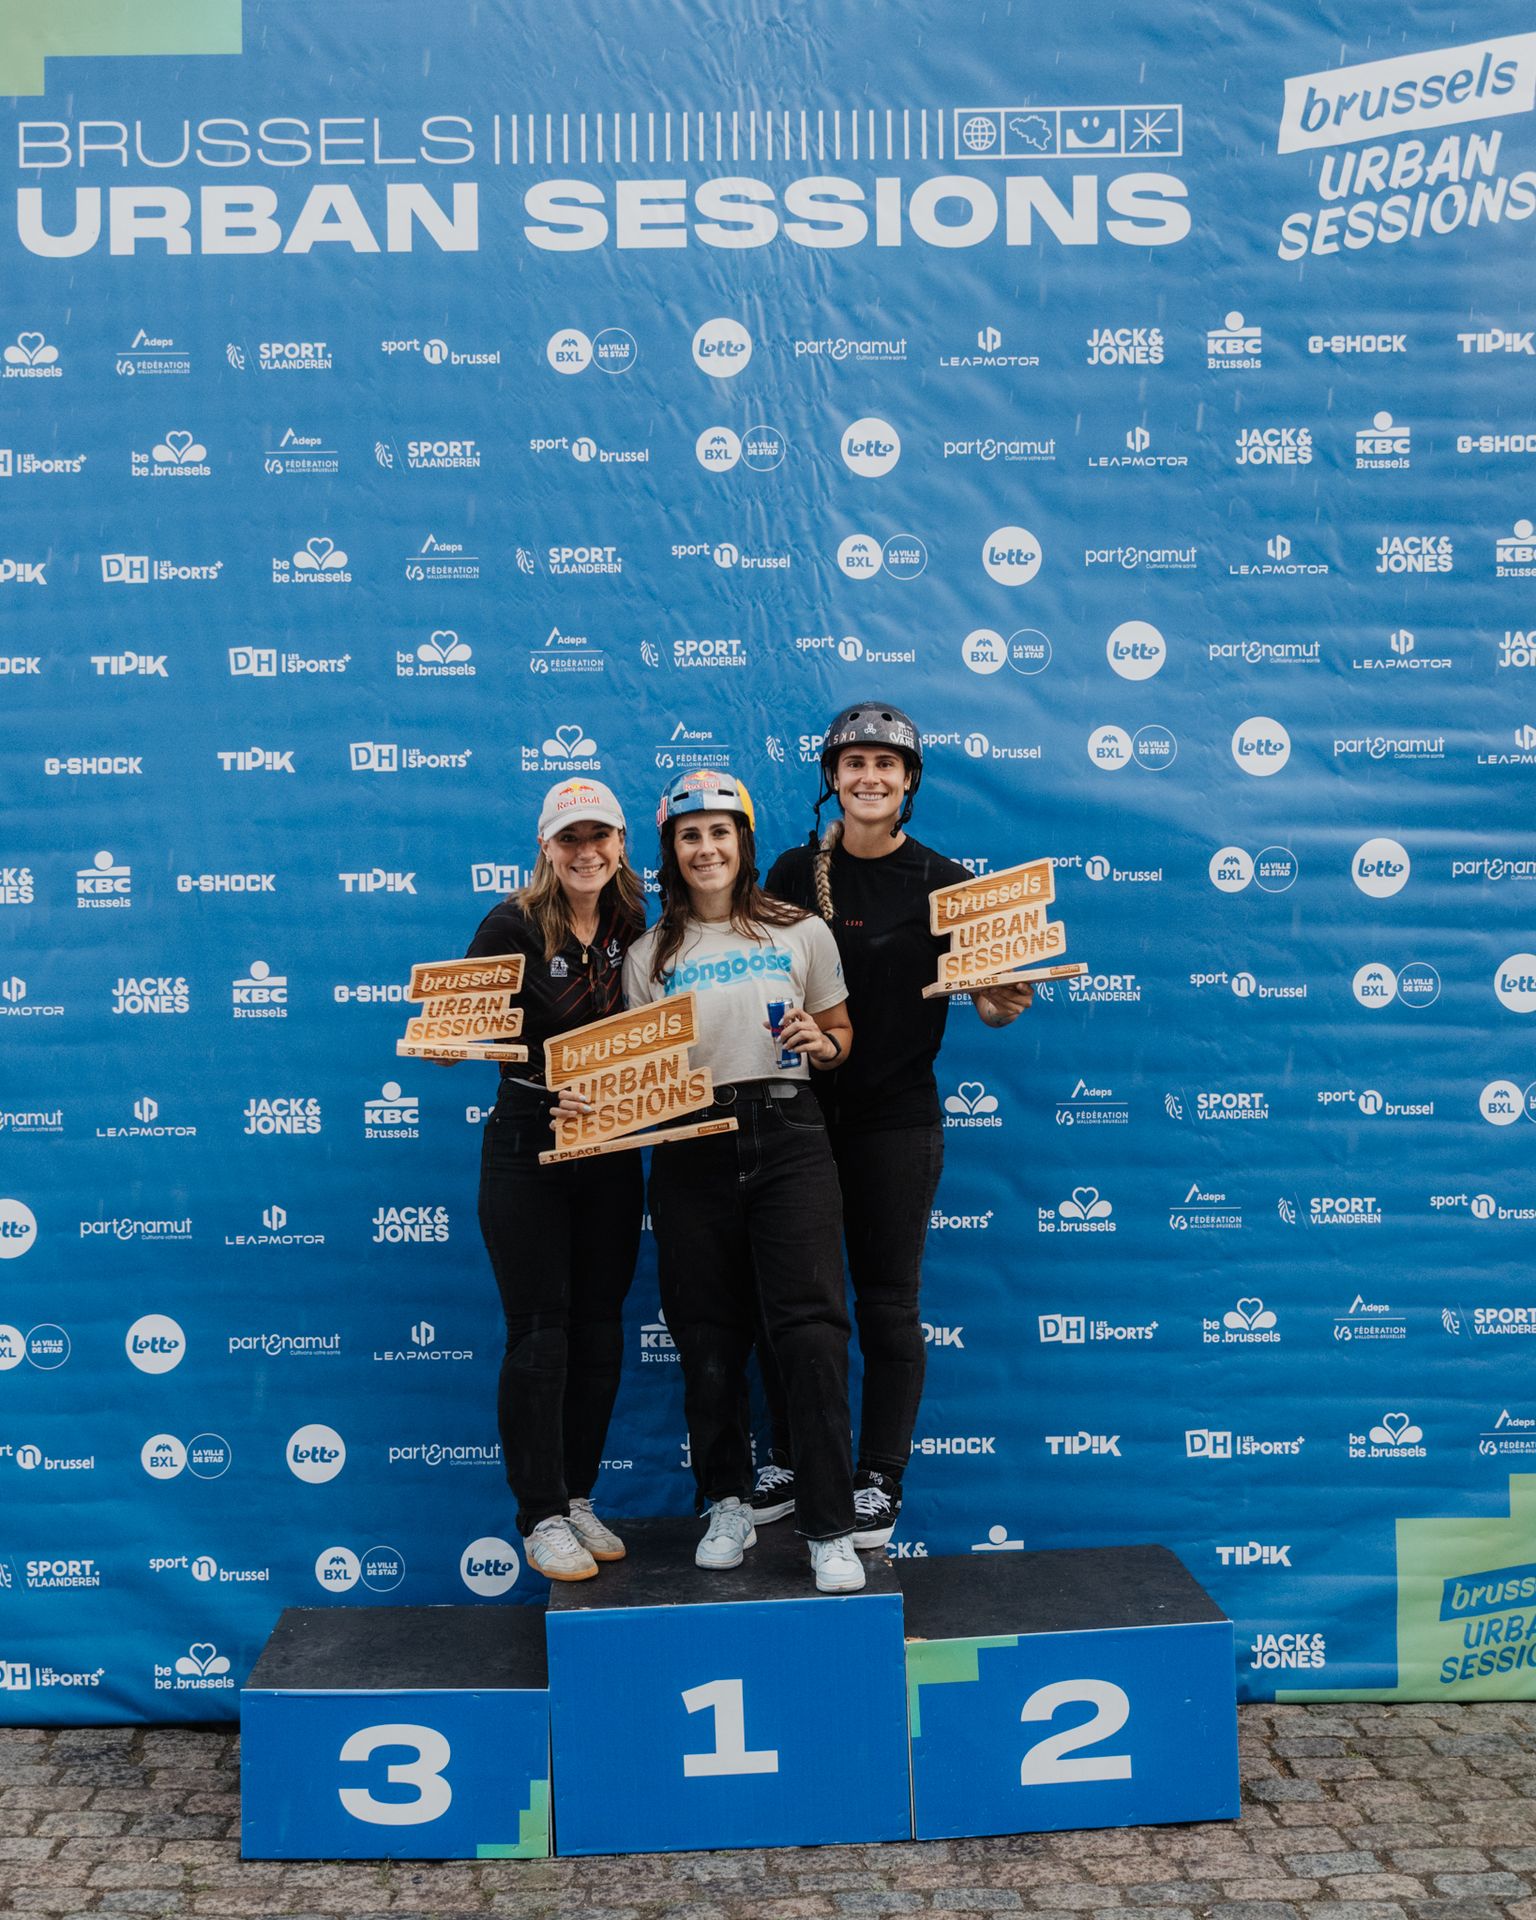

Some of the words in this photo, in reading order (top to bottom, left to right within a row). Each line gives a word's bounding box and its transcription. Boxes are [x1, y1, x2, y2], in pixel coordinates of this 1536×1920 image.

[1300, 52, 1518, 132] brussels
[18, 116, 475, 168] BRUSSELS
[1319, 130, 1503, 201] URBAN
[16, 182, 479, 258] URBAN
[523, 172, 1192, 252] SESSIONS
[1277, 171, 1536, 261] SESSIONS
[143, 337, 173, 348] Adeps
[382, 339, 420, 354] sport
[452, 350, 500, 364] brussel
[1208, 336, 1261, 354] KBC
[1309, 335, 1406, 352] G-SHOCK
[556, 351, 583, 361] BXL
[940, 357, 1038, 366] LEAPMOTOR
[1087, 346, 1164, 364] JONES
[1208, 358, 1261, 369] Brussels
[260, 360, 331, 369] VLAANDEREN
[530, 437, 568, 452] sport
[600, 448, 648, 462] brussel
[705, 449, 732, 459] BXL
[1356, 436, 1410, 454] KBC
[408, 458, 480, 468] VLAANDEREN
[1089, 457, 1187, 466] LEAPMOTOR
[1236, 446, 1312, 464] JONES
[1356, 458, 1410, 468] Brussels
[432, 542, 462, 553] Adeps
[672, 543, 710, 558] sport
[742, 554, 790, 568] brussel
[101, 554, 148, 583] DH
[549, 564, 621, 574] VLAANDEREN
[1230, 565, 1328, 574] LEAPMOTOR
[1376, 554, 1453, 572] JONES
[229, 646, 276, 676] DH
[971, 652, 998, 662] BXL
[1354, 660, 1452, 669] LEAPMOTOR
[682, 730, 712, 740] Adeps
[923, 733, 961, 748] sport
[992, 744, 1041, 758] brussel
[1096, 748, 1124, 758] BXL
[45, 757, 142, 774] G-SHOCK
[350, 742, 398, 771] DH
[557, 798, 577, 811] Red
[579, 795, 601, 806] Bull
[178, 874, 274, 892] G-SHOCK
[1218, 869, 1245, 880] BXL
[77, 875, 130, 893] KBC
[78, 897, 131, 908] Brussels
[946, 873, 1041, 919] brussels
[959, 909, 1039, 949] URBAN
[945, 926, 1060, 980] SESSIONS
[421, 965, 511, 992] brussels
[959, 976, 1000, 988] PLACE
[1191, 973, 1228, 987] sport
[1259, 984, 1306, 997] brussel
[233, 985, 286, 1003] KBC
[234, 1007, 287, 1018] Brussels
[428, 996, 504, 1018] URBAN
[410, 1013, 518, 1041] SESSIONS
[562, 1012, 682, 1072] brussels
[424, 1048, 468, 1058] PLACE
[579, 1054, 679, 1105] URBAN
[1082, 1087, 1112, 1098] Adeps
[562, 1074, 705, 1145] SESSIONS
[1318, 1090, 1355, 1105] sport
[1386, 1101, 1433, 1114] brussel
[365, 1106, 418, 1124] KBC
[1197, 1110, 1269, 1120] VLAANDEREN
[98, 1127, 196, 1136] LEAPMOTOR
[244, 1116, 321, 1134] JONES
[366, 1128, 419, 1138] Brussels
[560, 1147, 602, 1160] PLACE
[1310, 1214, 1380, 1223] VLAANDEREN
[226, 1236, 324, 1245] LEAPMOTOR
[373, 1224, 449, 1242] JONES
[1360, 1303, 1389, 1313] Adeps
[1039, 1314, 1085, 1343] DH
[374, 1351, 472, 1360] LEAPMOTOR
[911, 1438, 994, 1454] -SHOCK
[1185, 1429, 1232, 1458] DH
[150, 1456, 178, 1466] BXL
[150, 1556, 188, 1572] sport
[220, 1568, 268, 1581] brussel
[324, 1569, 352, 1580] BXL
[27, 1578, 99, 1587] VLAANDEREN
[1251, 1650, 1325, 1669] JONES
[681, 1679, 779, 1777] 1
[1020, 1678, 1133, 1786] 2
[338, 1724, 453, 1826] 3
